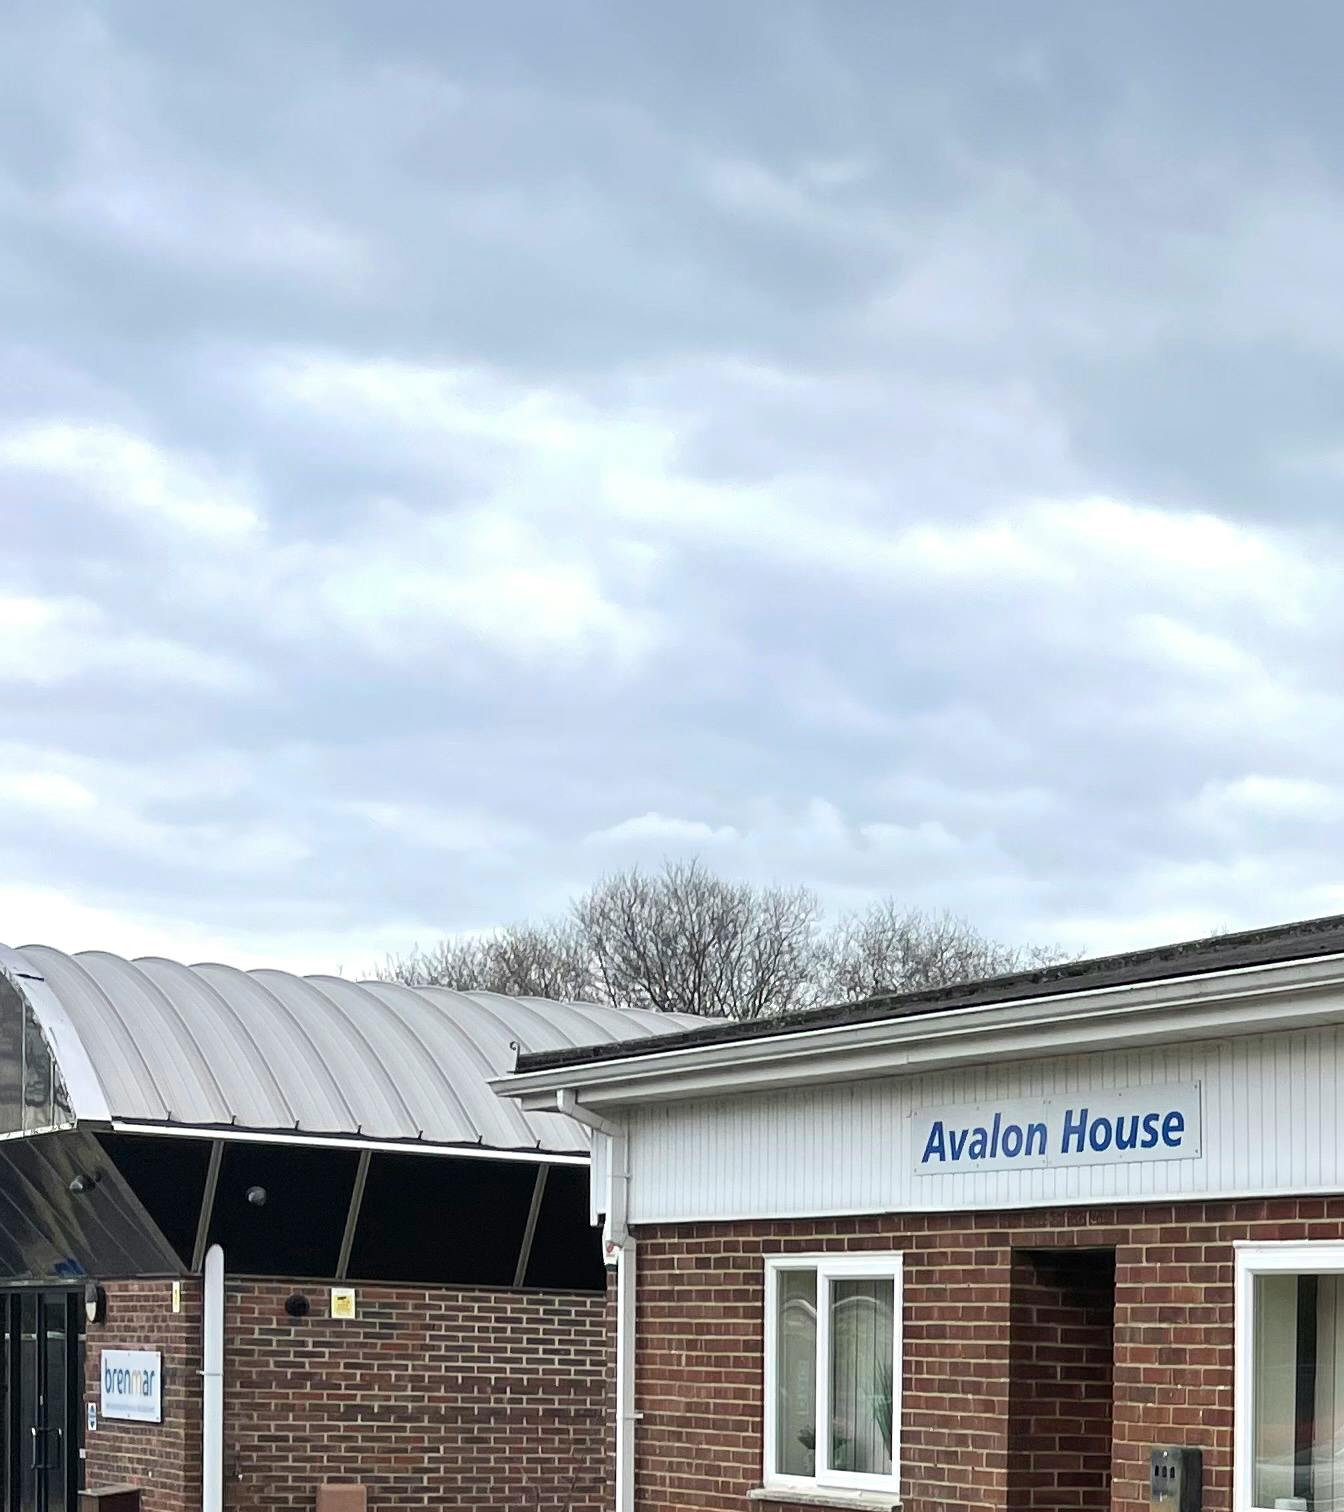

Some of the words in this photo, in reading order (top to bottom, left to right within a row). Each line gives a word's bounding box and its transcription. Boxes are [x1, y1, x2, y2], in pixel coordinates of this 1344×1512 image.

[921, 1112, 1048, 1164] Avalon
[1060, 1108, 1185, 1154] House
[104, 1358, 155, 1397] brenmar
